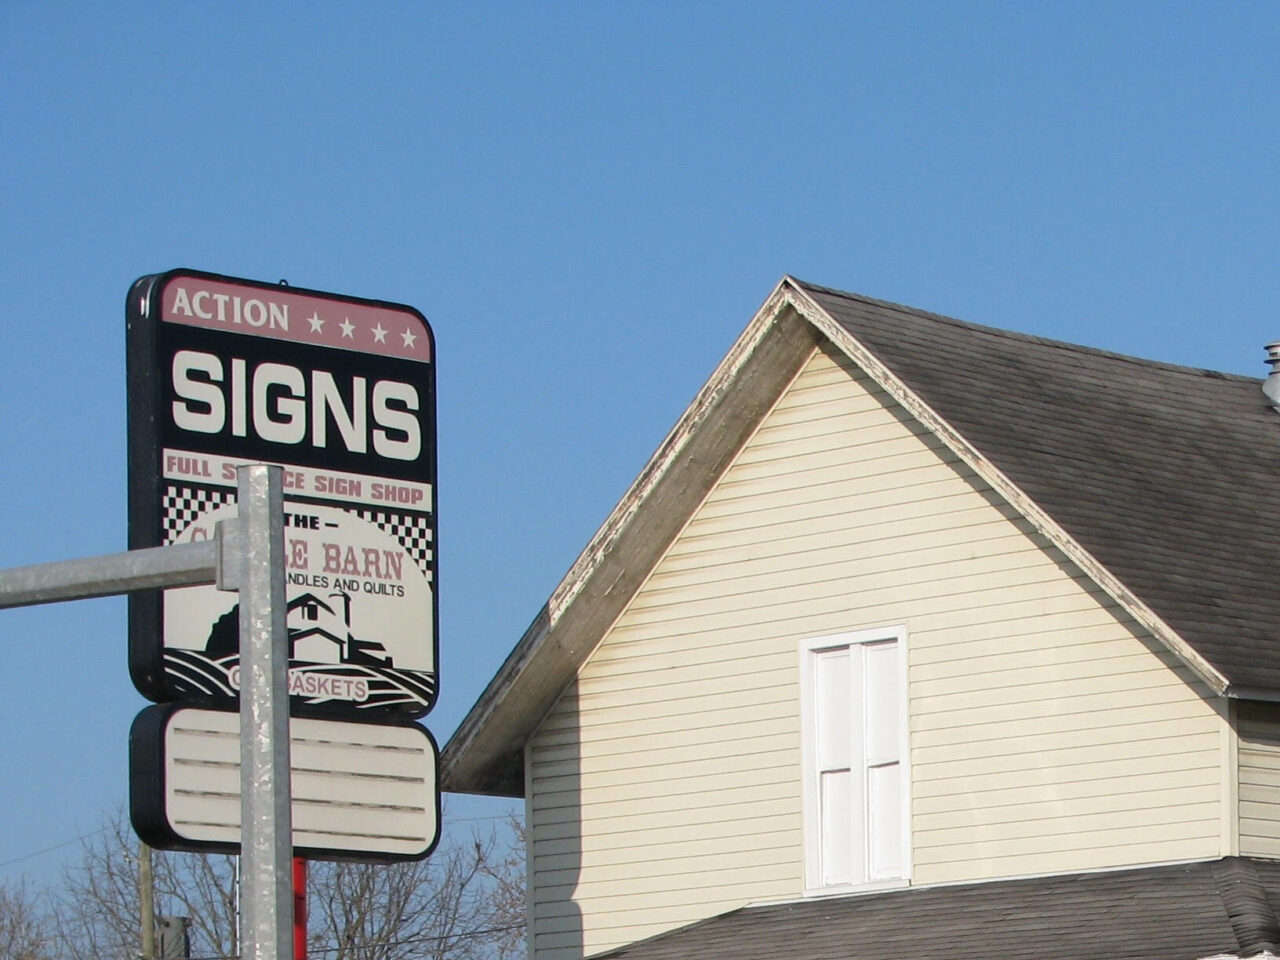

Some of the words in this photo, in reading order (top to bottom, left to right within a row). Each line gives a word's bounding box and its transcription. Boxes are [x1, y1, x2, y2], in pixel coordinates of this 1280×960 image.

[171, 288, 289, 332] ACTION
[172, 350, 422, 461] SIGNS
[167, 456, 212, 478] FULL
[315, 475, 361, 497] SIGN
[371, 483, 424, 504] SHOP
[284, 513, 320, 530] THE
[322, 542, 404, 581] BARN
[285, 572, 329, 588] NDLES
[333, 578, 360, 592] AND
[363, 581, 405, 597] QUILTS
